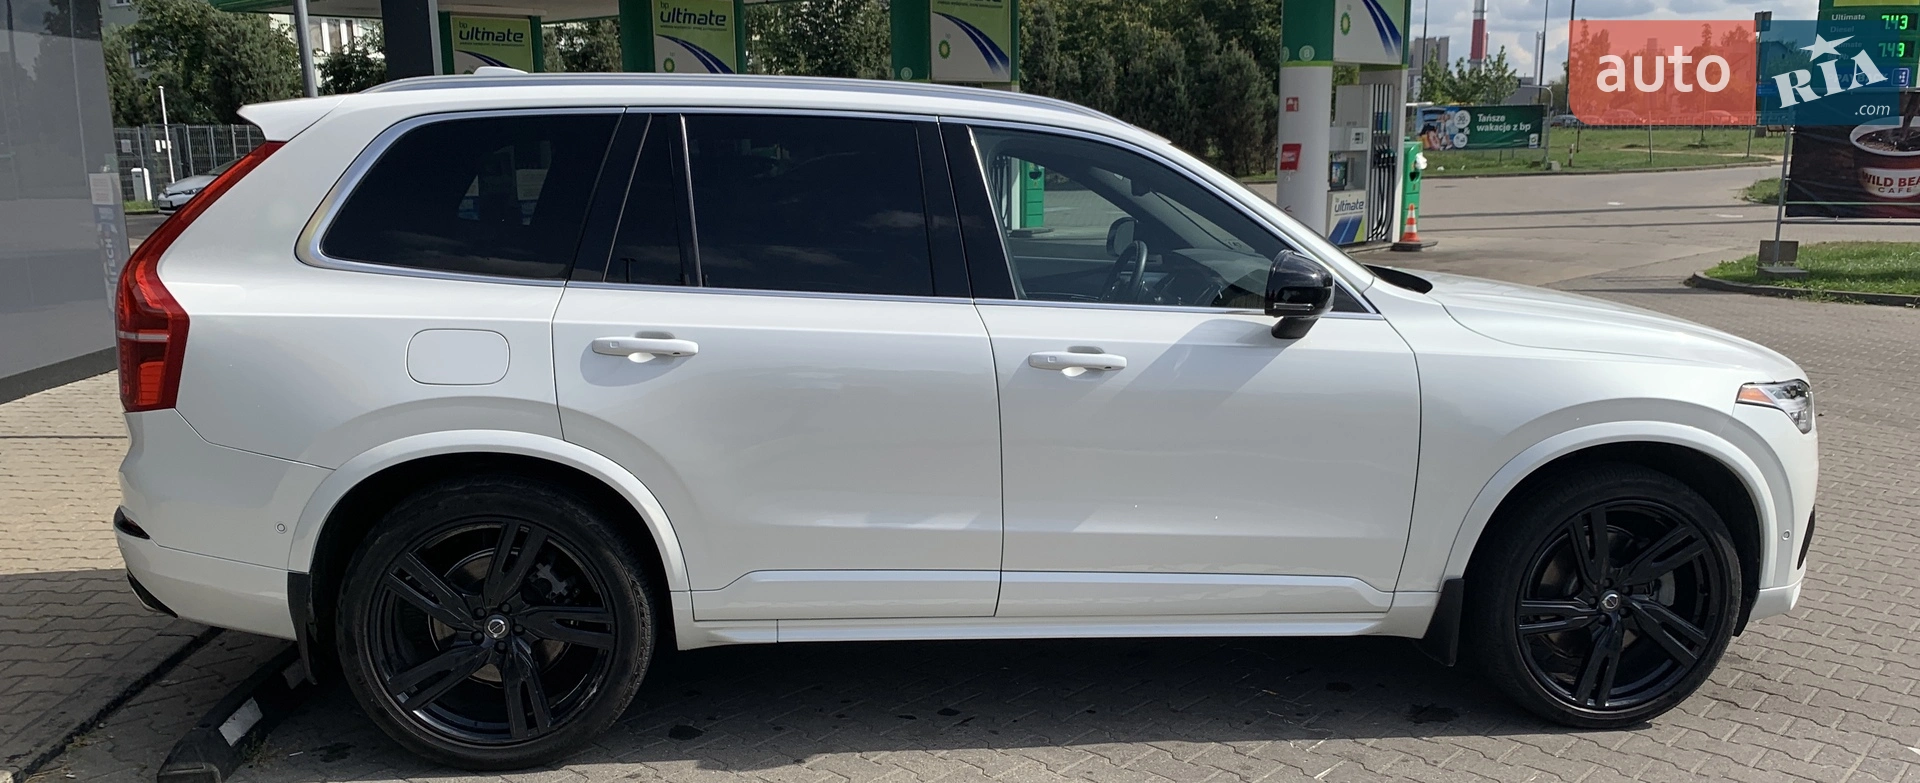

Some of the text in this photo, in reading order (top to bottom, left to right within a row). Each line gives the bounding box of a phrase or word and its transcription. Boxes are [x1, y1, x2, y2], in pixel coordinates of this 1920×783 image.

[660, 7, 727, 26] ultimate
[459, 26, 524, 43] ultimate
[1476, 122, 1511, 133] wakacje
[1519, 122, 1531, 132] bp
[1862, 171, 1894, 187] WILD
[1335, 199, 1365, 213] ultimate
